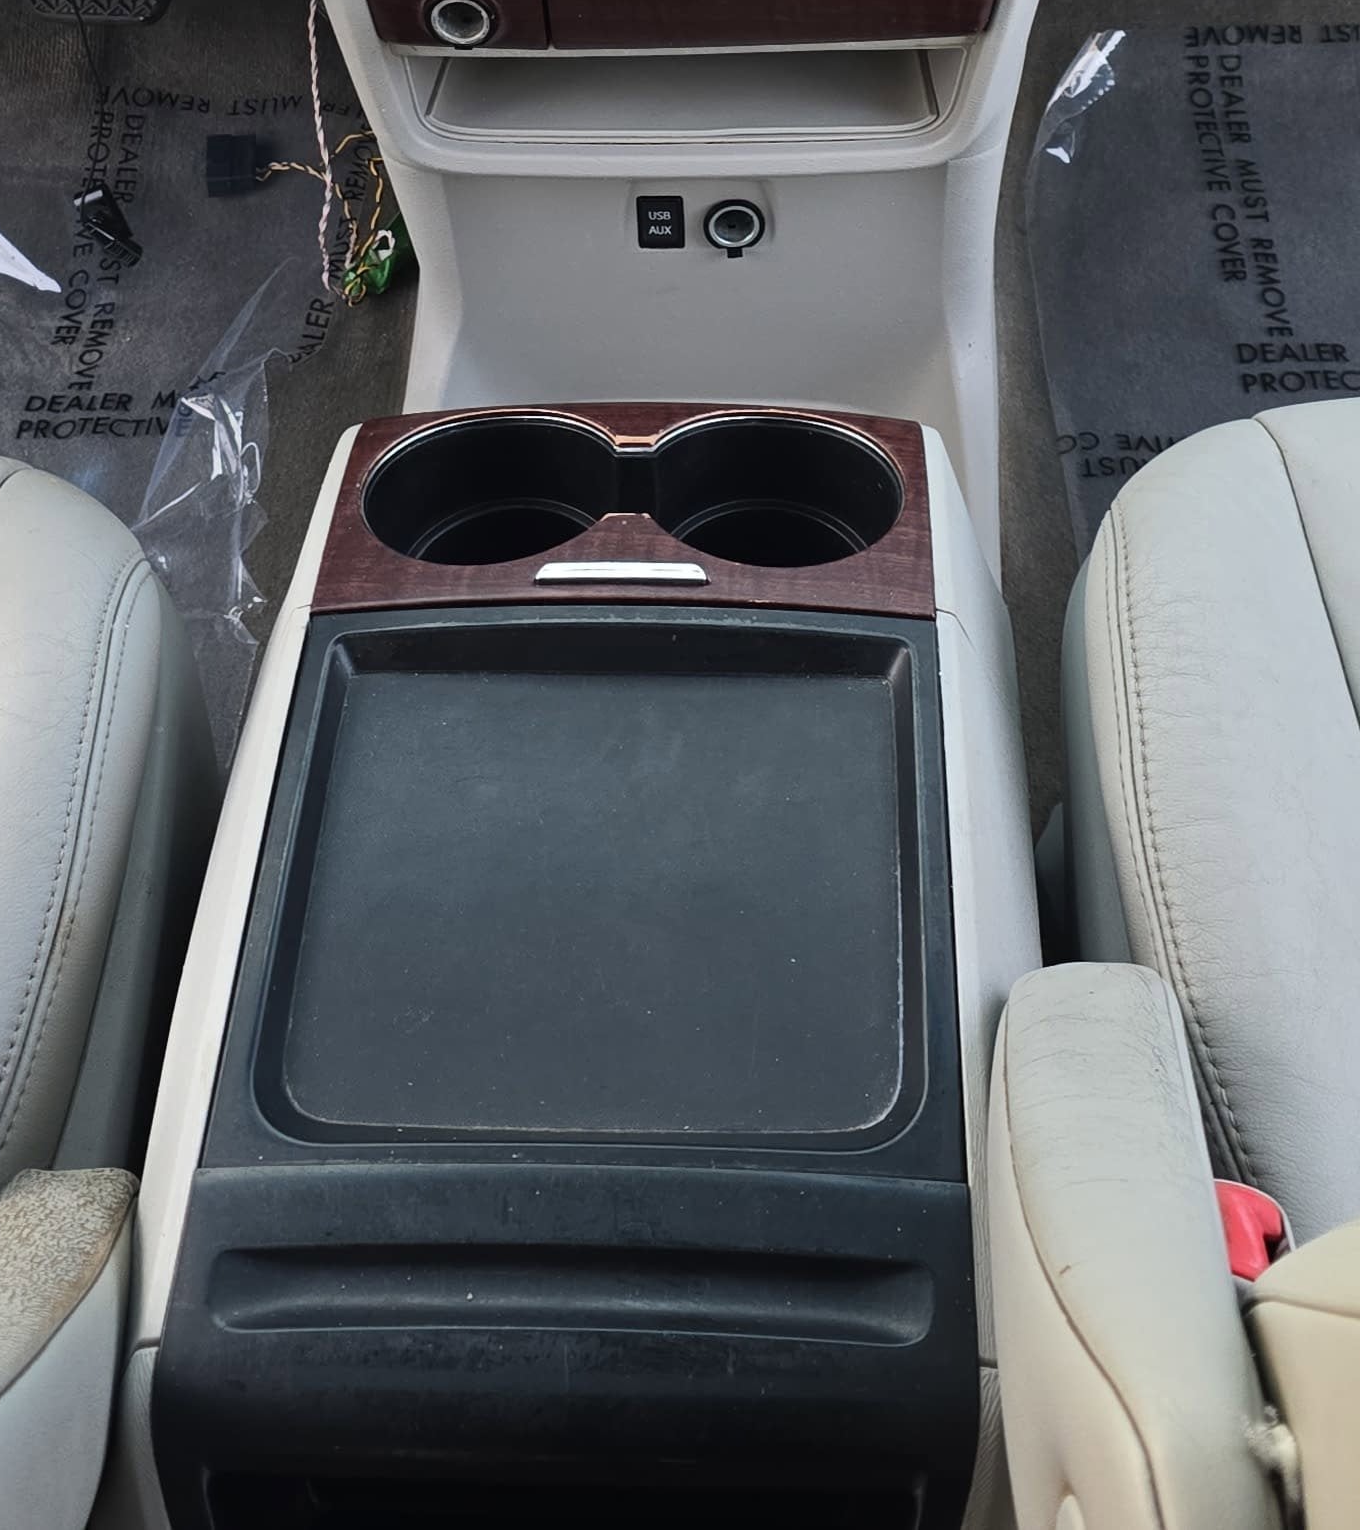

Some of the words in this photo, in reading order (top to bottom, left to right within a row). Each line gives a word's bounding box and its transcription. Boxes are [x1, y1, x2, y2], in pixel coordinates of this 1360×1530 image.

[1184, 23, 1304, 47] REMOVE
[227, 93, 303, 115] MUST
[1217, 55, 1252, 146] DEALER
[116, 111, 145, 205] DEALER
[1184, 54, 1233, 192] PROTECTIVE
[1210, 203, 1248, 285] COVER
[1235, 156, 1271, 225] MUST
[648, 210, 671, 221] USB
[648, 225, 672, 235] AUX
[1249, 237, 1295, 338] REMOVE
[52, 269, 90, 347] COVER
[72, 301, 116, 391] REMOVE
[1237, 341, 1348, 365] DEALER
[24, 392, 133, 414] DEALER
[16, 416, 193, 440] PROTECTIVE
[1081, 456, 1148, 479] UST
